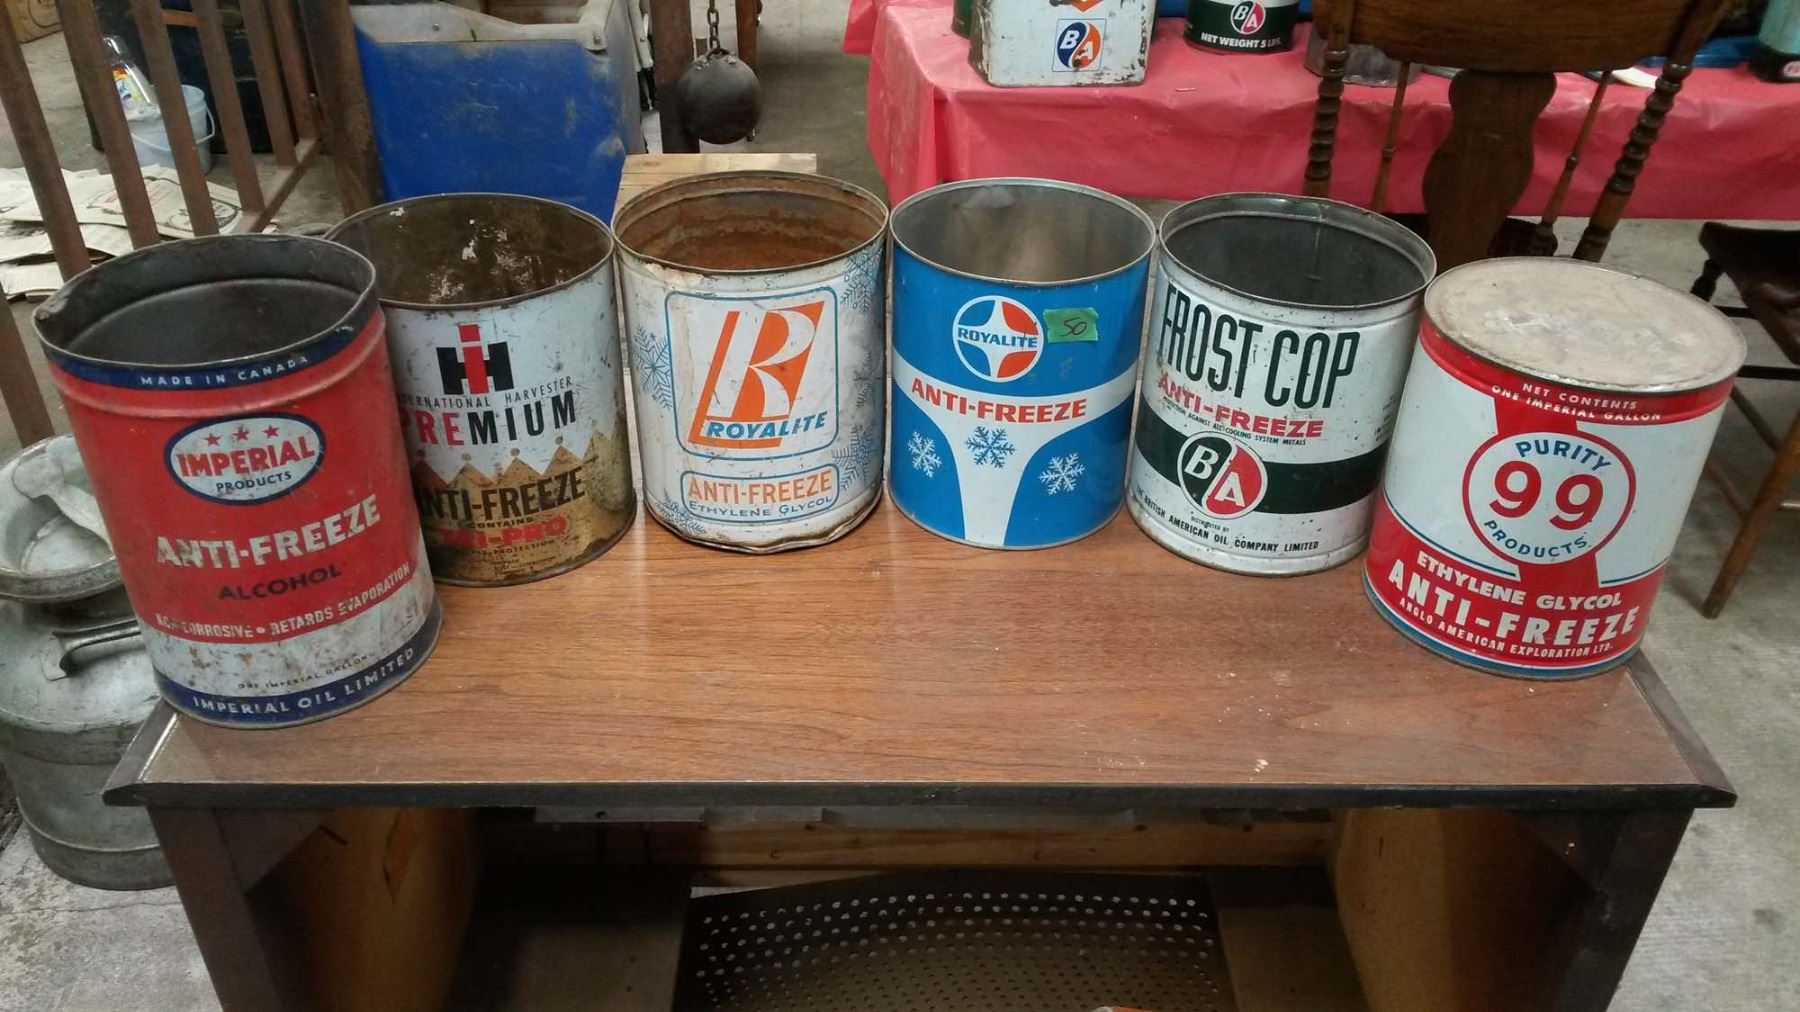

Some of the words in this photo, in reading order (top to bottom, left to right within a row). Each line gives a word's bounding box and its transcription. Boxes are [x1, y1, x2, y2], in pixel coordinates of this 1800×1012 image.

[1201, 32, 1218, 44] NET
[1219, 37, 1260, 48] WEIGHT
[1260, 40, 1267, 48] 5
[957, 326, 1038, 349] ROYALITE
[1060, 317, 1088, 337] 50
[1159, 281, 1264, 399] FROST
[1264, 329, 1361, 409] COP
[140, 375, 193, 387] MADE
[205, 373, 226, 386] IN
[237, 355, 309, 382] CANADA
[504, 376, 573, 404] HARVESTER
[911, 377, 1088, 424] ANTI-FREEZE
[1157, 371, 1325, 438] ANTI-FREEZE
[1491, 385, 1519, 402] ONE
[1525, 396, 1596, 419] IMPERIAL
[1604, 411, 1662, 422] GALLON
[1522, 383, 1548, 398] NET
[1558, 391, 1638, 410] CONTENTS
[706, 411, 829, 440] ROYALITE
[1187, 412, 1212, 427] AGAINST
[1225, 427, 1253, 440] COOLING
[1254, 435, 1279, 445] SYSTEM
[1282, 439, 1307, 447] METALS
[176, 436, 316, 478] IMPERIAL
[1516, 438, 1612, 472] PURITY
[216, 471, 292, 492] PRODUCTS
[688, 469, 833, 505] ANTI-FREEZE
[467, 516, 535, 529] CONTAINS
[689, 501, 771, 518] ETHYLENE
[778, 496, 833, 515] GLYCOL
[1144, 495, 1167, 518] BRITISH
[1168, 515, 1209, 540] AMERICAN
[1214, 534, 1229, 546] OIL
[1234, 539, 1279, 552] COMPANY
[1284, 540, 1320, 552] LIMITED
[156, 494, 382, 569] ANTI-FREEZE
[1484, 519, 1589, 558] PRODUCTS
[218, 564, 343, 600] ALCOHOL
[270, 608, 334, 636] RETARDS
[338, 562, 411, 616] EVAPORATION
[1417, 551, 1527, 606] ETHYLENE
[1536, 592, 1622, 611] GLYCOL
[1388, 559, 1640, 646] ANTI-FREEZE
[1399, 598, 1434, 625] ANGLO
[1438, 620, 1505, 652] AMERICAN
[1510, 644, 1590, 658] EXPLORATION
[193, 695, 290, 714] IMPERIAL
[297, 690, 337, 709] OIL
[344, 647, 415, 695] LIMITED
[265, 672, 323, 688] IMPERIAL
